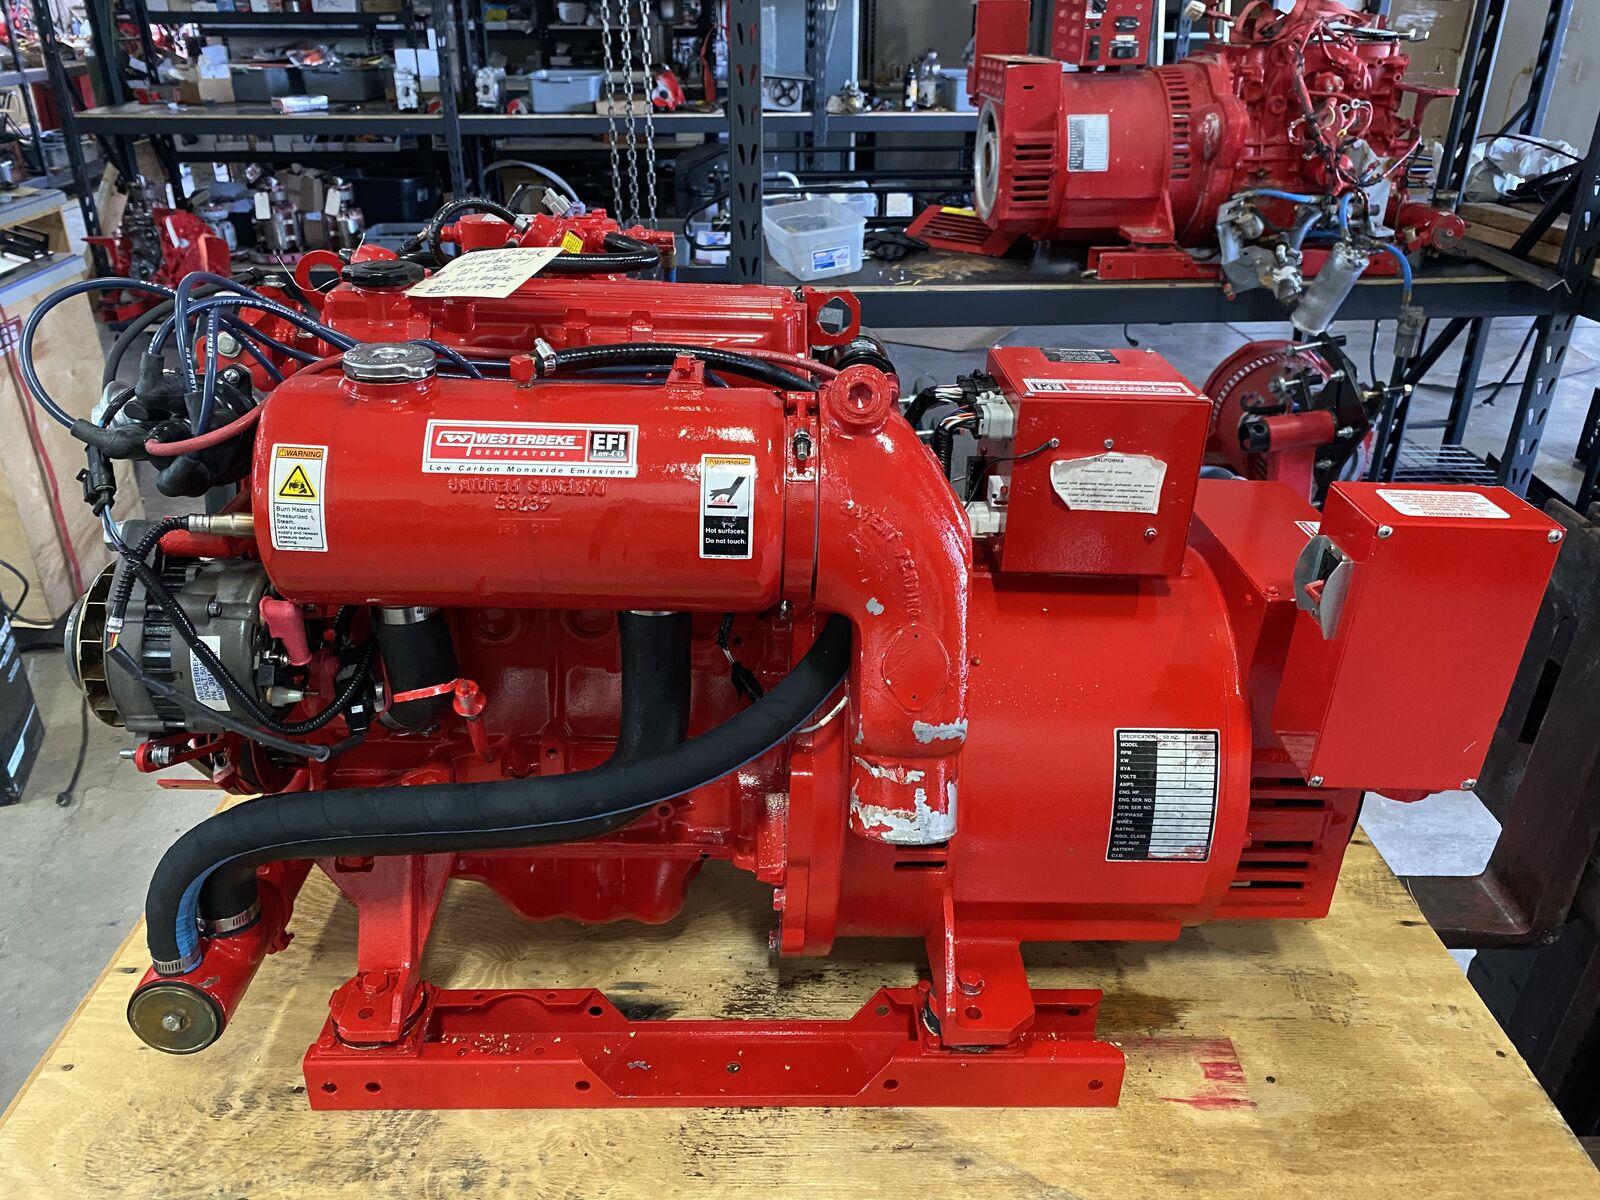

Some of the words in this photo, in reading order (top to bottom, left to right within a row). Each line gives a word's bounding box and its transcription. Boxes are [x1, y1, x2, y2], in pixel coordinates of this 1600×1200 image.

[476, 432, 576, 446] WESTERBEKE
[593, 433, 626, 450] EFI
[286, 450, 322, 458] WARNING
[475, 449, 566, 458] GENERATORS
[593, 450, 625, 458] Low-CO
[429, 464, 452, 472] Low
[507, 466, 563, 474] Monoxide
[570, 467, 630, 476] Emissions
